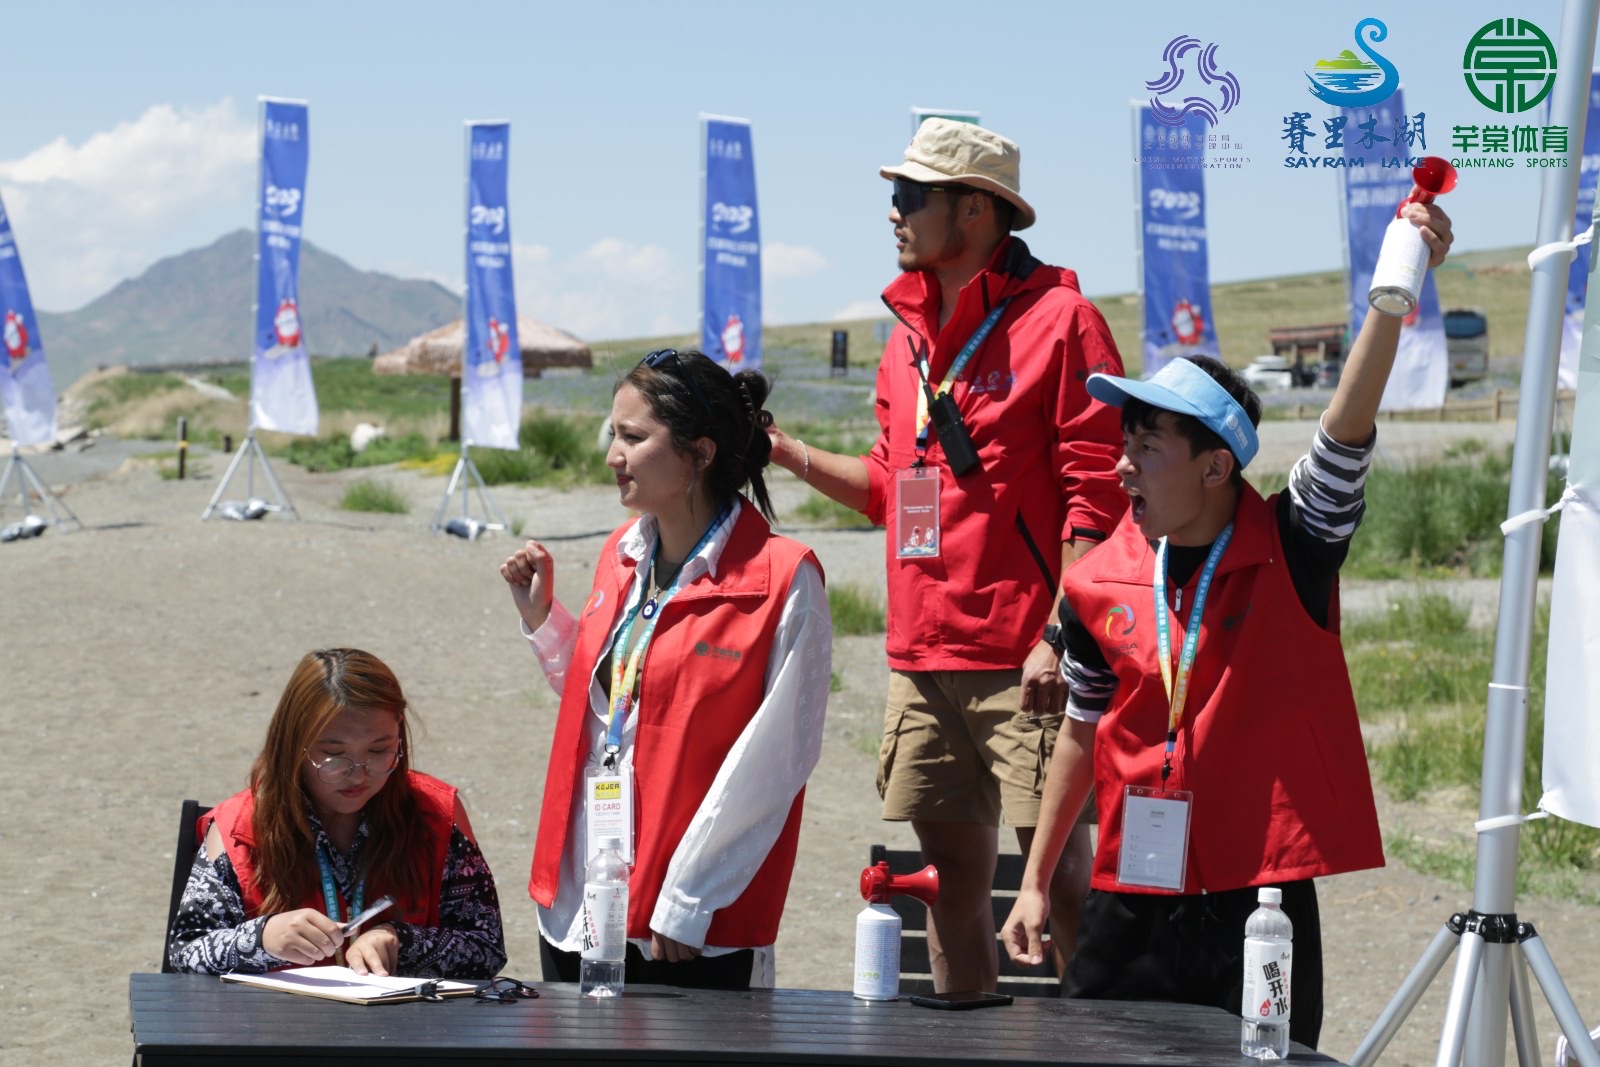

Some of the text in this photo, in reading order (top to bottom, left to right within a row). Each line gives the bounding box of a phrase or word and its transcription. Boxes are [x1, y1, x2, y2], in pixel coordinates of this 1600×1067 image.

[594, 803, 621, 812] ID CARD
[1262, 960, 1289, 1017] 喝开水
